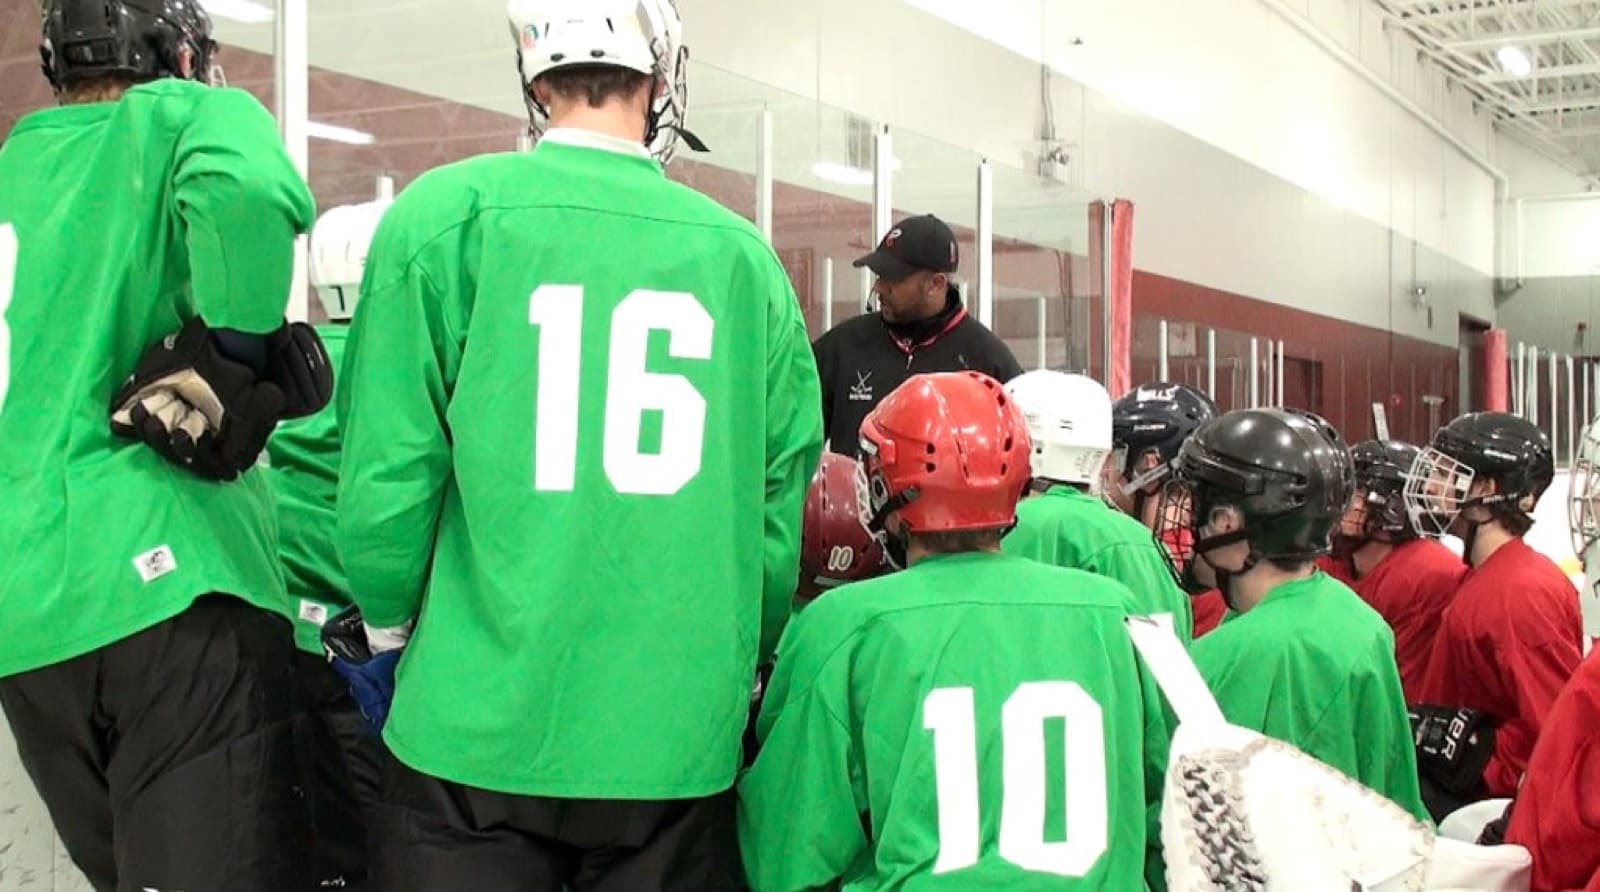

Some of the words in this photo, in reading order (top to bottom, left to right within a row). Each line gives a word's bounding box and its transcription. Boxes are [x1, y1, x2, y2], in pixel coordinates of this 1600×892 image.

[529, 284, 716, 496] 16
[827, 545, 854, 571] 10
[923, 680, 1109, 878] 10
